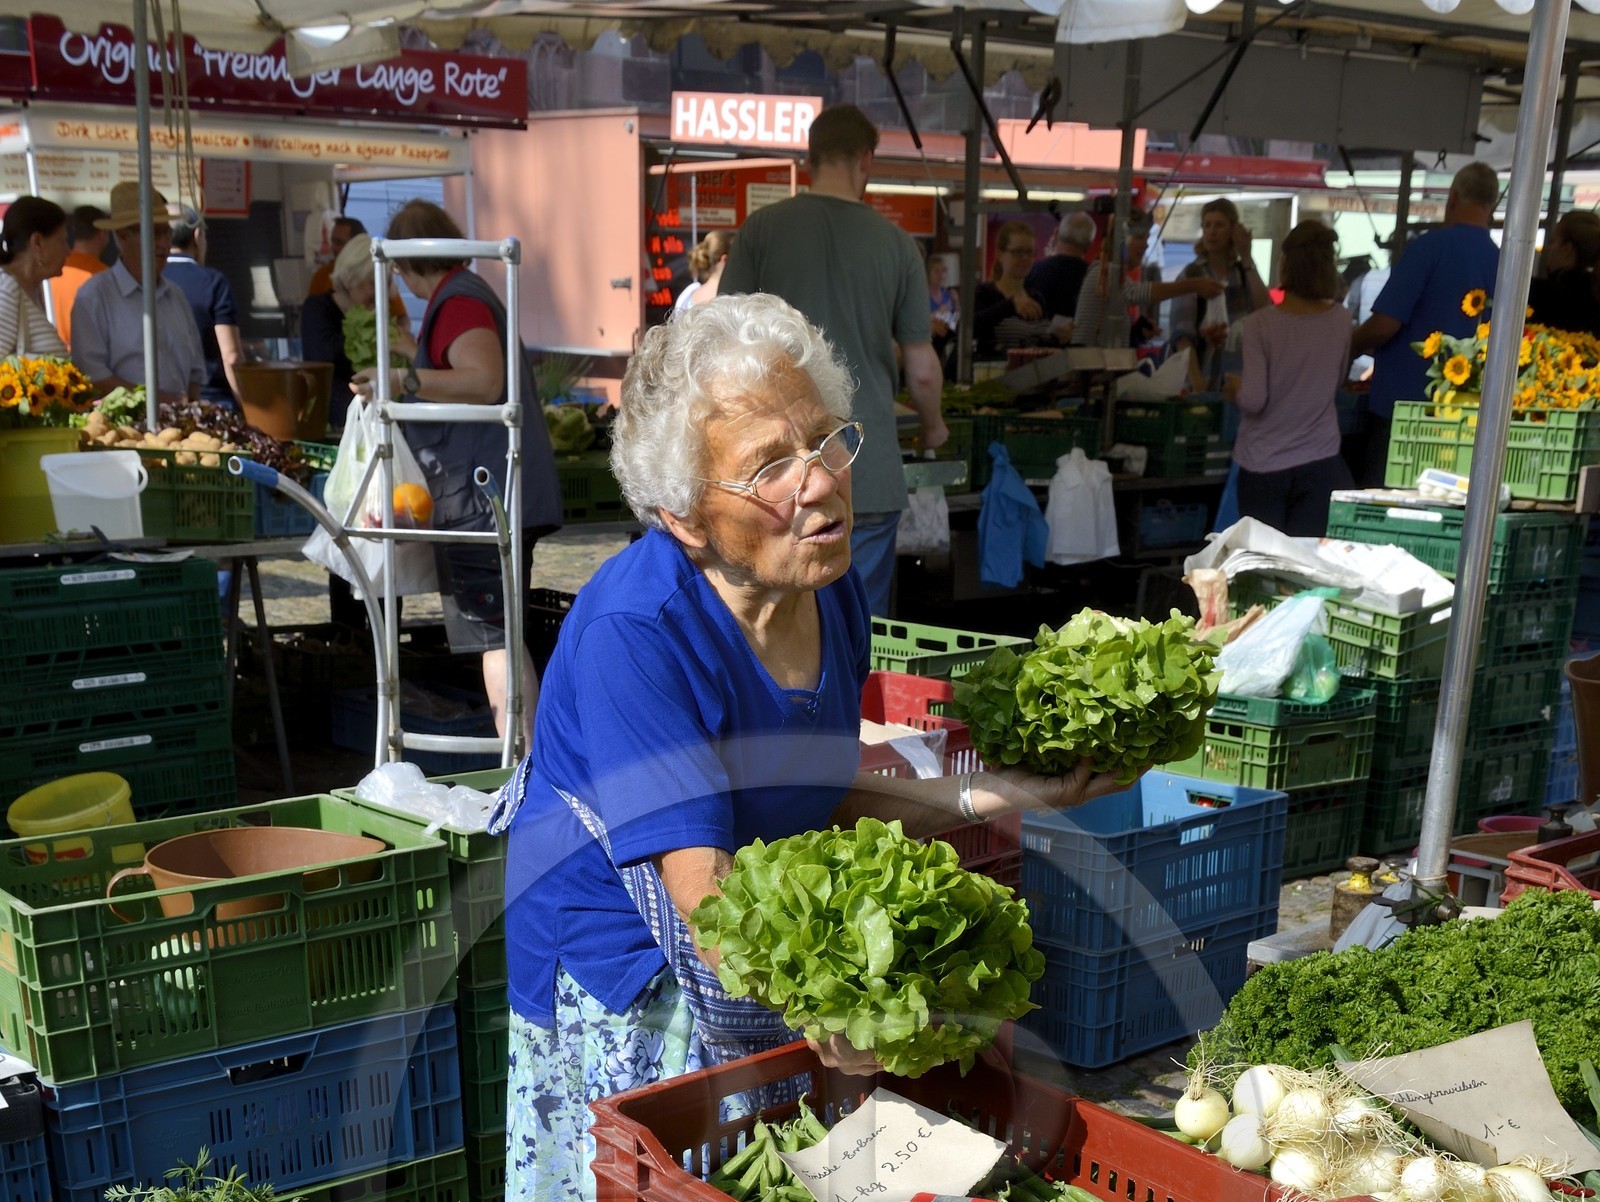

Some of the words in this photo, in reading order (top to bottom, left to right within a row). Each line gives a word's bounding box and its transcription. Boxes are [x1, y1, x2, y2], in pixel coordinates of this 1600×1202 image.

[356, 63, 436, 105] Lange
[57, 119, 90, 140] Dirk
[675, 97, 815, 143] HASSLER
[841, 1125, 887, 1161] Erbsen
[880, 1140, 918, 1173] 2.50
